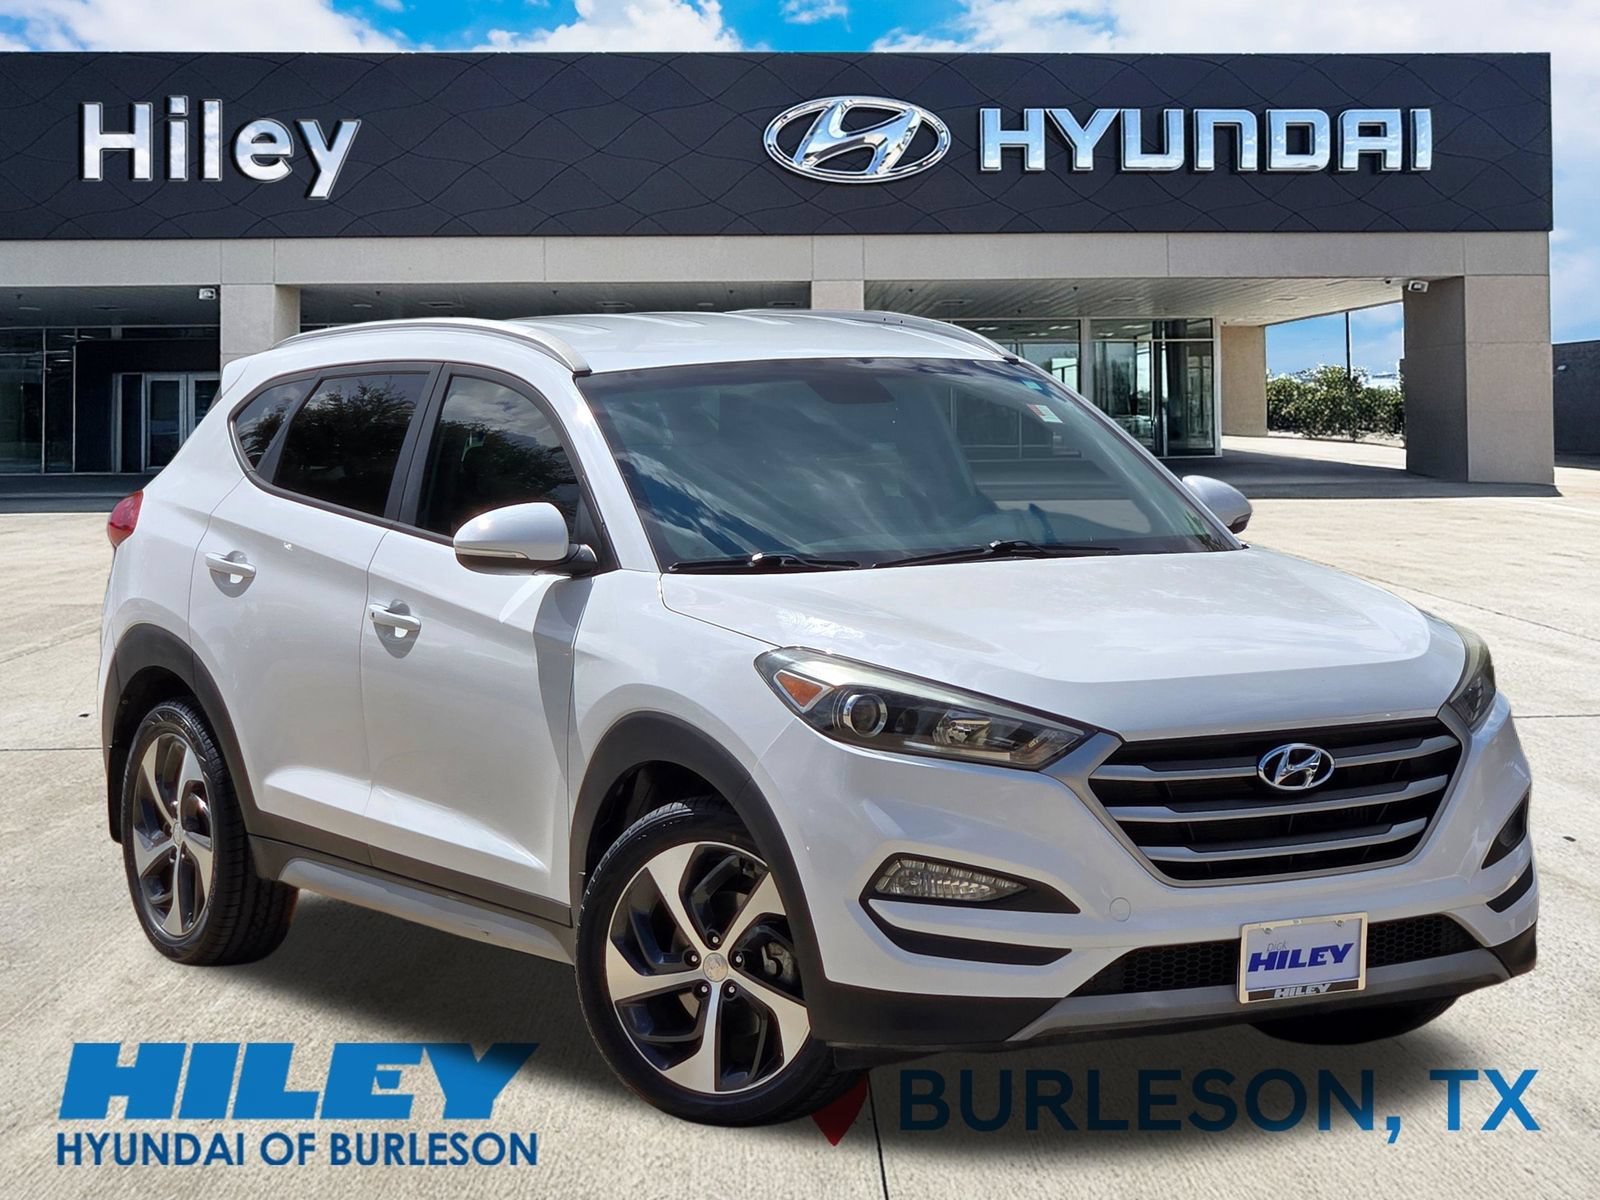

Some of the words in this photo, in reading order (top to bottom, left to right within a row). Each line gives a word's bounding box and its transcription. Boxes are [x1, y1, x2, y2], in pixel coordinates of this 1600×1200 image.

[80, 96, 362, 200] Hiley
[979, 107, 1433, 172] HYUNDAI
[1247, 942, 1354, 972] HILEY
[1273, 983, 1331, 999] HILEY
